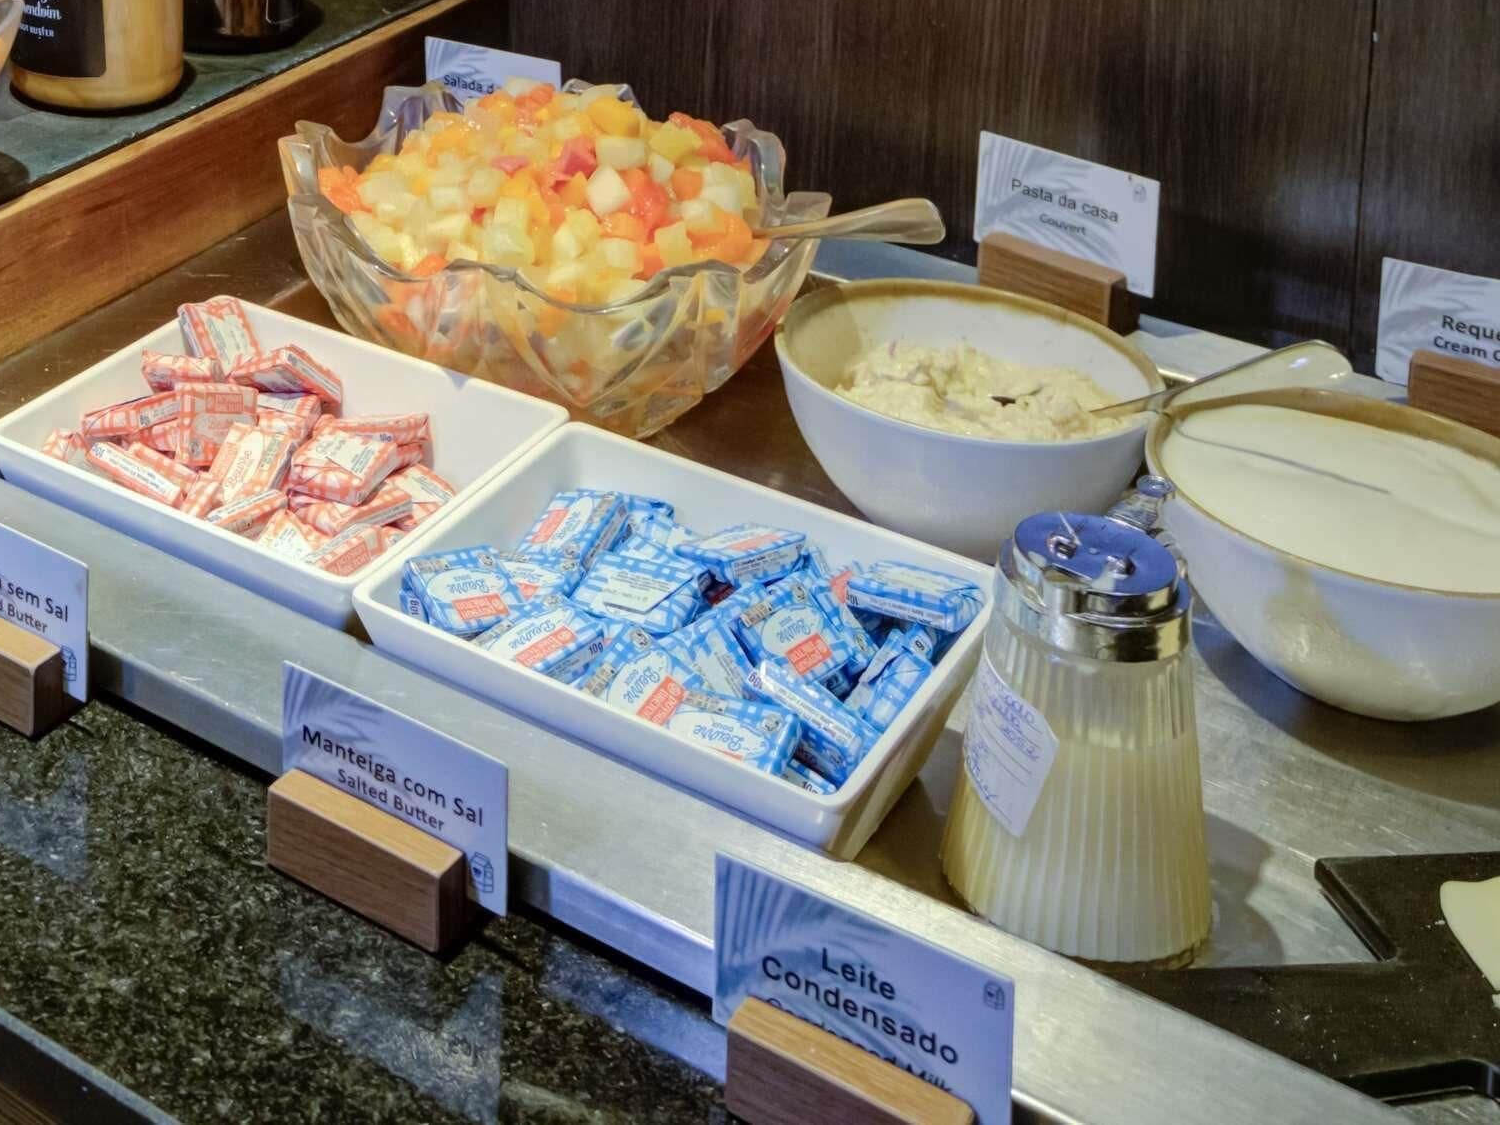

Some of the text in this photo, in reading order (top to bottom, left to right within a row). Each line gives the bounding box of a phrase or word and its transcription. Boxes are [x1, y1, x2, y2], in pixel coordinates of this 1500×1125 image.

[443, 74, 483, 92] Salada
[1011, 178, 1118, 223] Pasta da casa
[1038, 214, 1087, 236] Couvert
[1433, 336, 1487, 359] Cream
[7, 579, 36, 605] sem
[38, 588, 69, 623] Sal
[7, 601, 48, 635] Butter
[589, 641, 604, 655] 10g
[692, 725, 745, 753] Beurre
[303, 725, 484, 828] Manteiga com Sal
[338, 768, 445, 832] Salted Butter
[822, 947, 897, 1001] Leite
[762, 956, 959, 1065] Condensado
